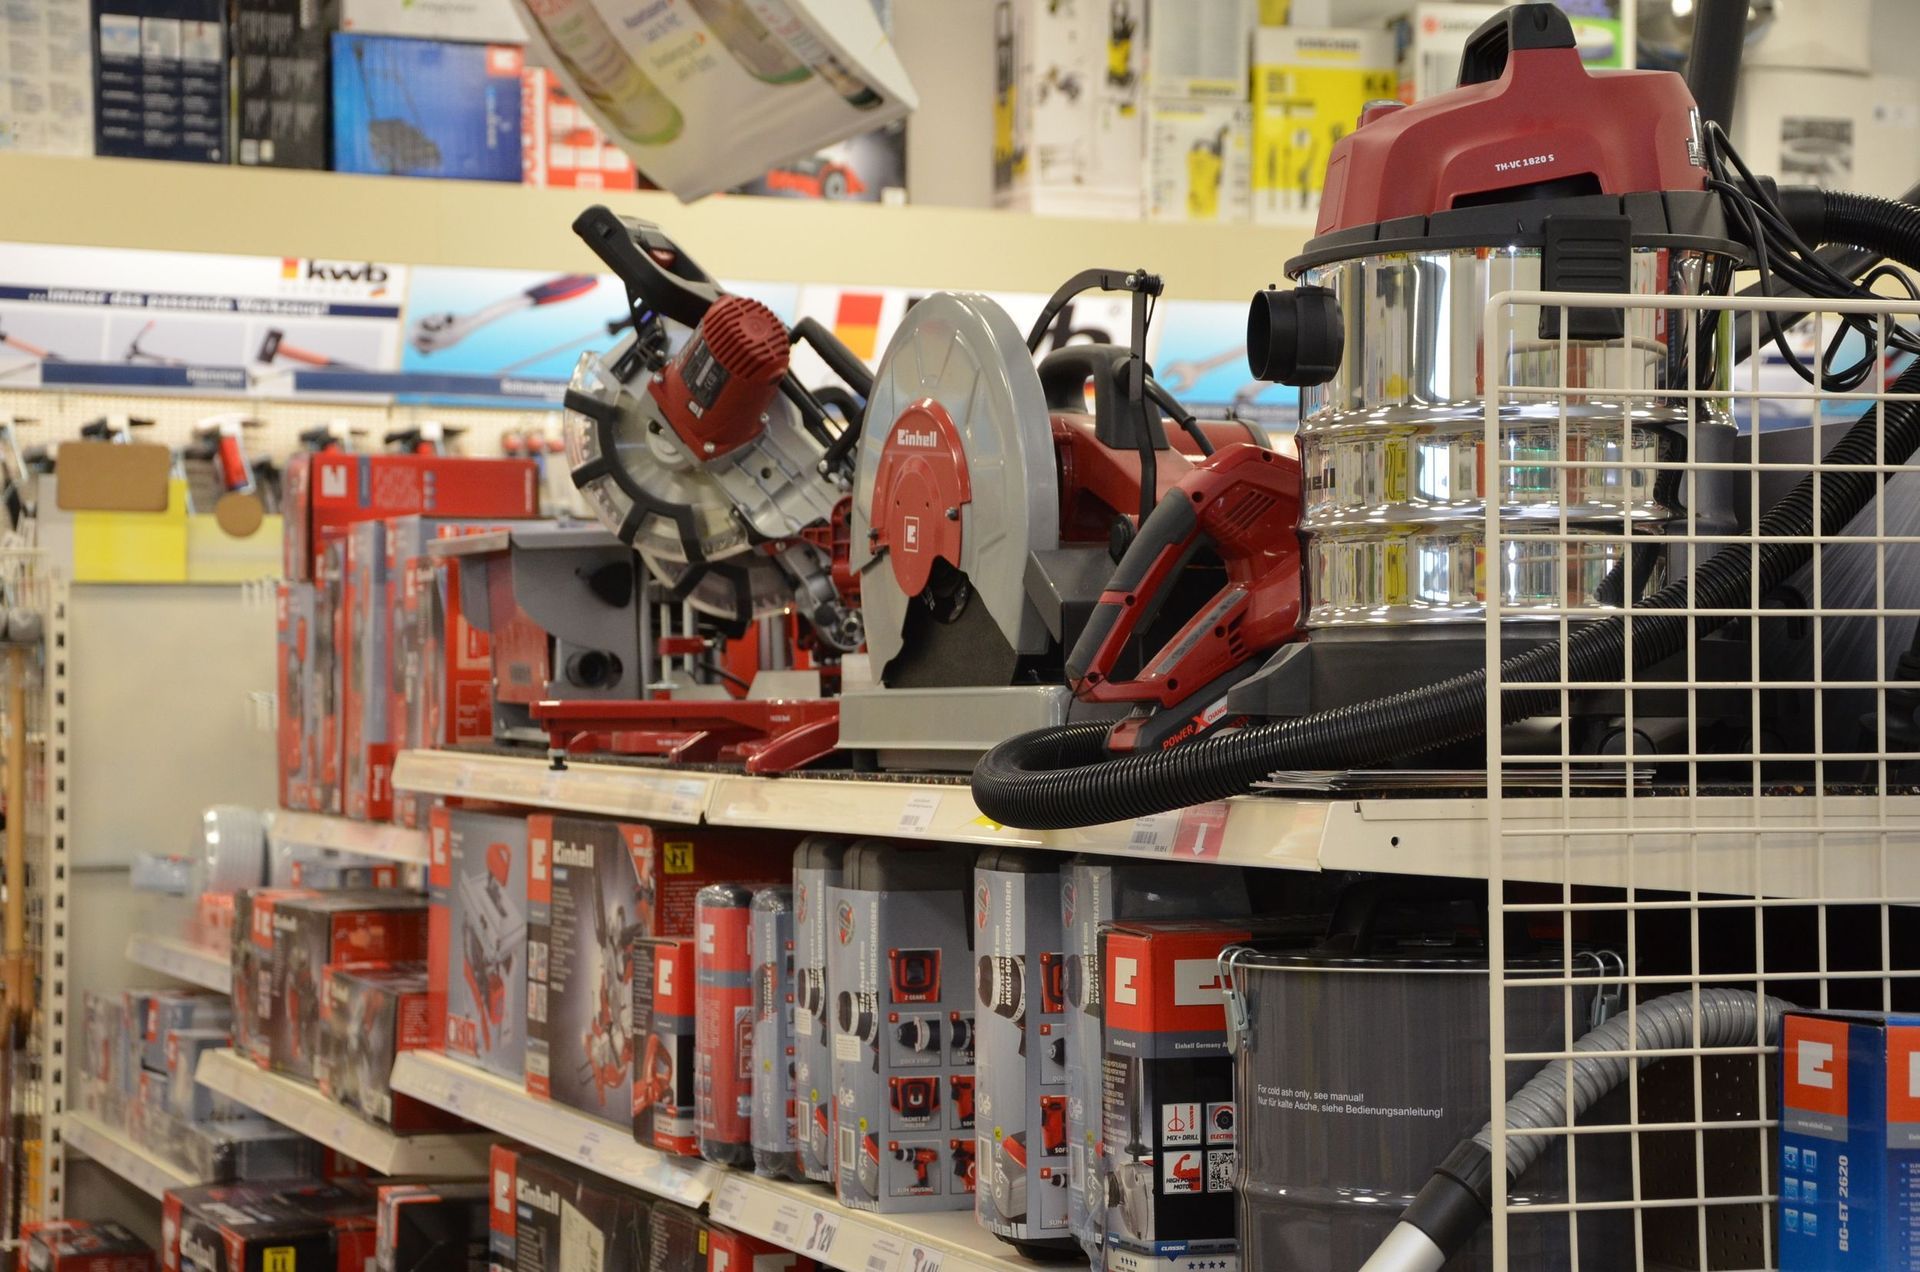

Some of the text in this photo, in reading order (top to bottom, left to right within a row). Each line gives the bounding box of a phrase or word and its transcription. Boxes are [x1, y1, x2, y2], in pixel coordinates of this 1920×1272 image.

[1495, 154, 1555, 171] TH-VC 1820 S
[307, 260, 388, 283] kwb
[897, 429, 937, 447] Einhell
[1163, 724, 1195, 751] POWER
[553, 840, 594, 868] Einhell
[869, 901, 878, 1014] AKKU-BOHRSCHRAUBER
[1258, 1084, 1364, 1103] For cold ash only, see manual!
[1258, 1096, 1268, 1106] Nur
[1277, 1097, 1293, 1109] kalte
[1294, 1101, 1320, 1113] Asche,
[1321, 1103, 1344, 1114] siehe
[1345, 1103, 1444, 1119] Bedienungsanleitung!
[1839, 1155, 1849, 1252] BG-ET 2620
